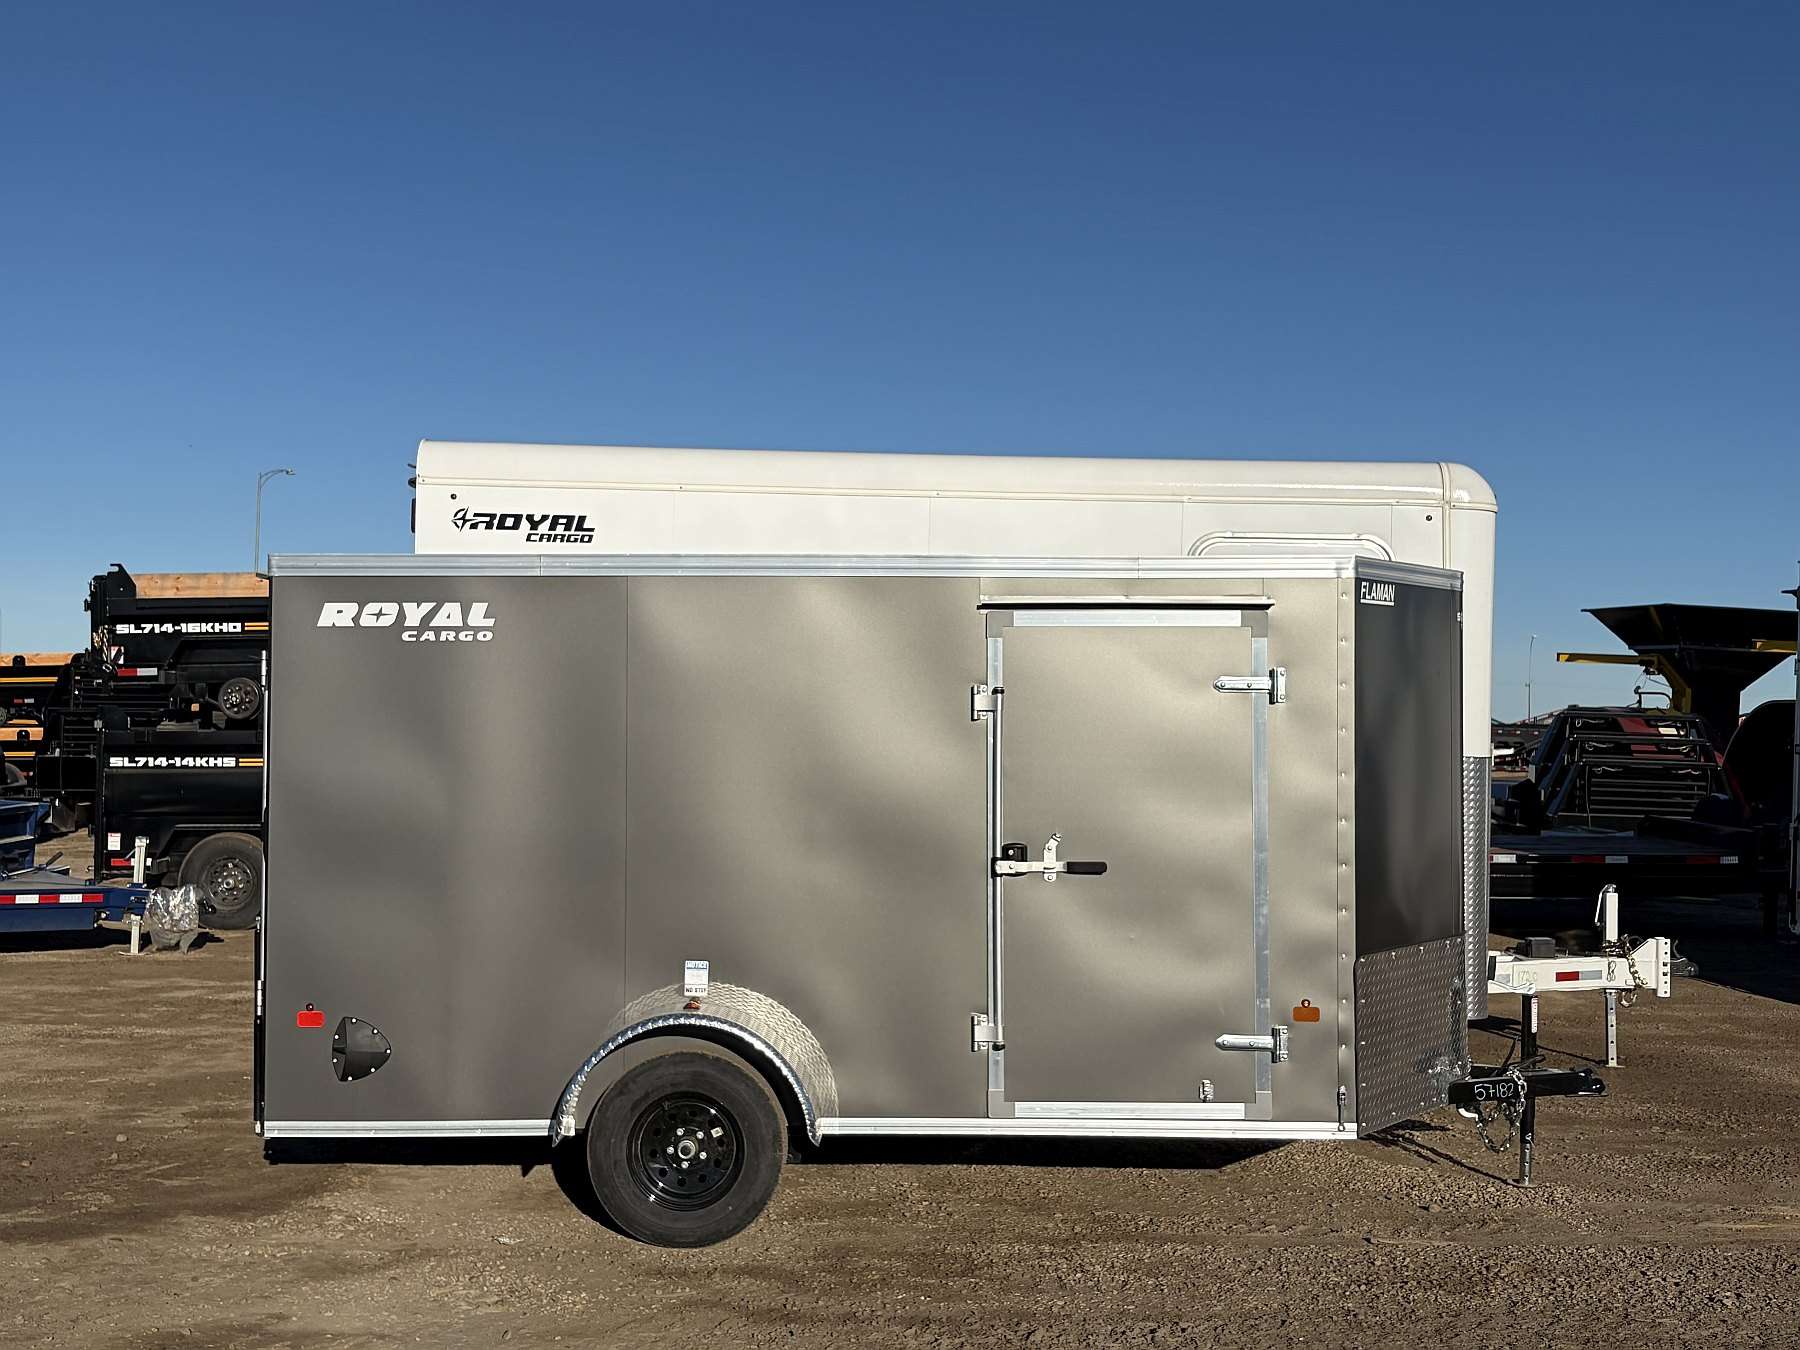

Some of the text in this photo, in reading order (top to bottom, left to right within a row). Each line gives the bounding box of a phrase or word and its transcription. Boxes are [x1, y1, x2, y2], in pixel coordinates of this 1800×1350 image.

[468, 512, 596, 533] ROYAL
[525, 532, 595, 545] CARGO
[1360, 581, 1396, 602] FLAMAN
[316, 601, 496, 628] ROYAL
[401, 630, 495, 643] CARGO
[109, 756, 237, 768] SL714-14KHS
[1474, 1082, 1514, 1101] 57182
